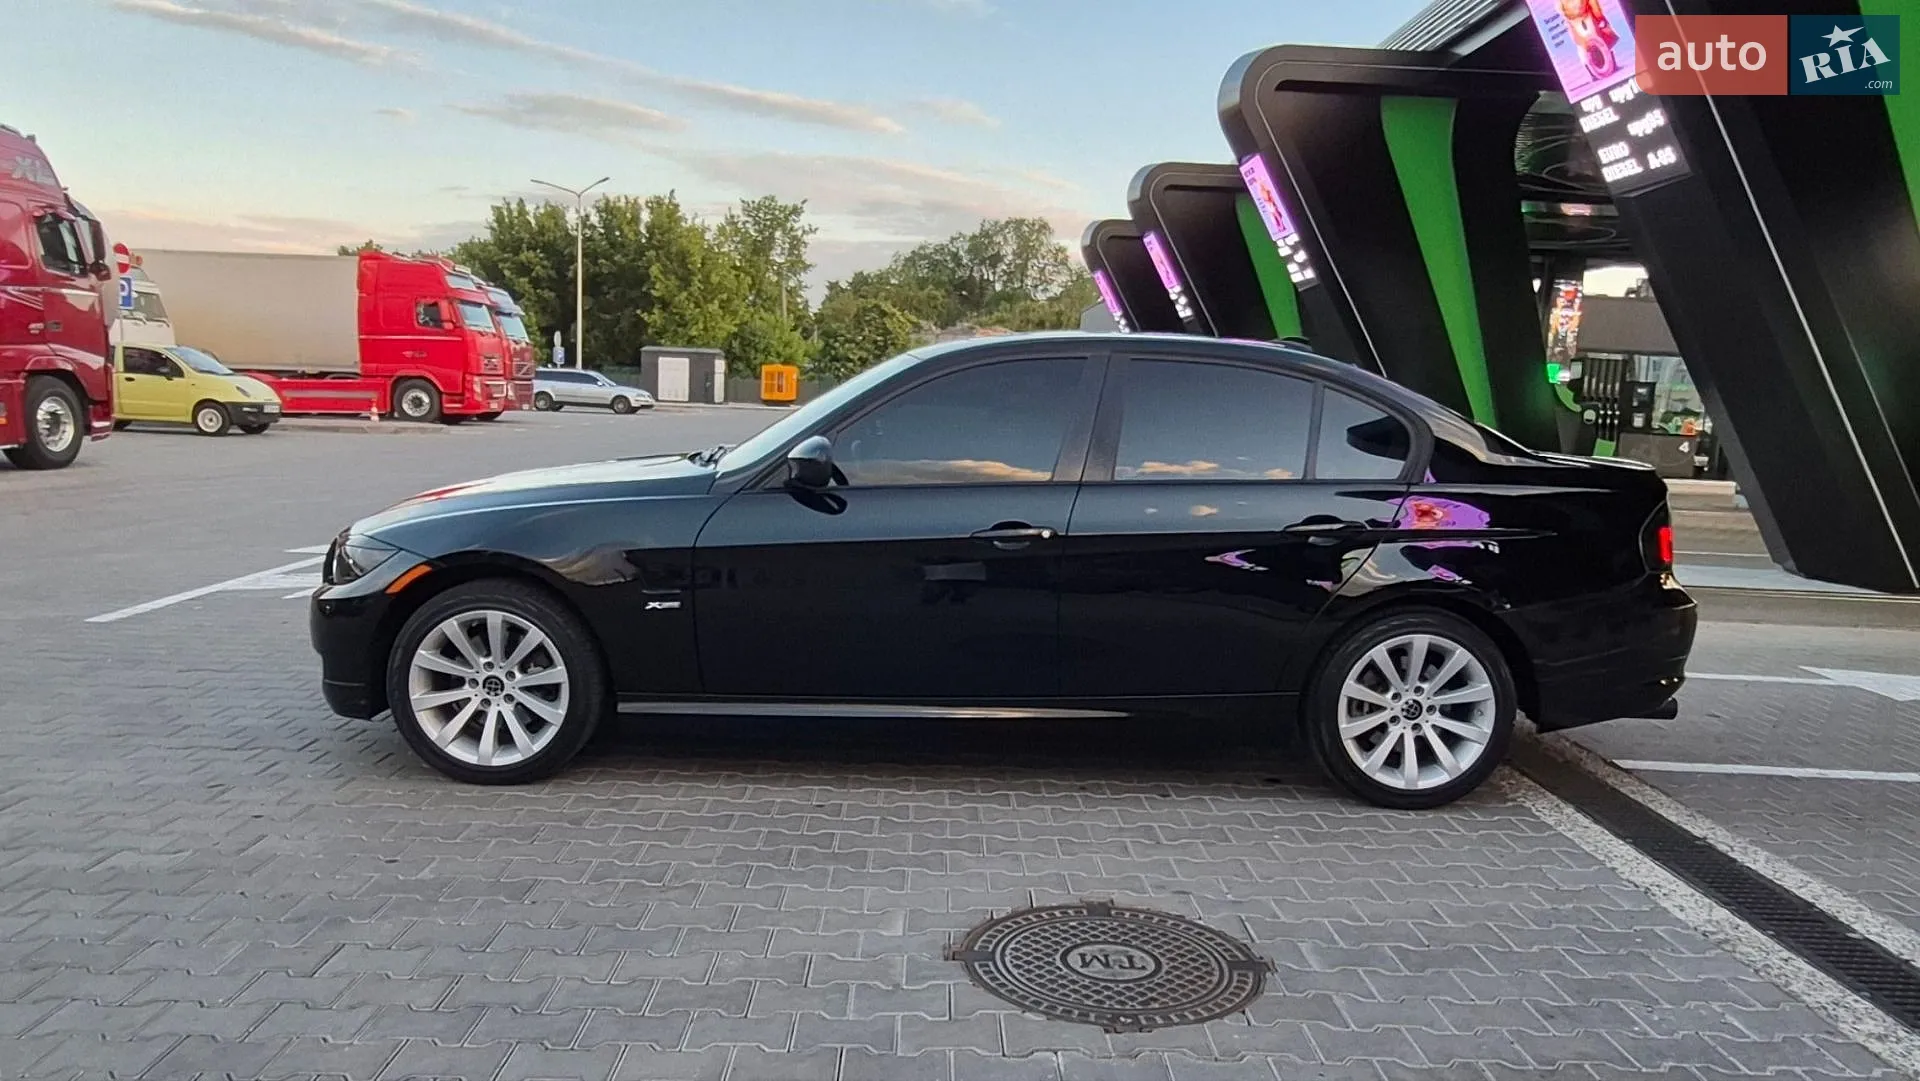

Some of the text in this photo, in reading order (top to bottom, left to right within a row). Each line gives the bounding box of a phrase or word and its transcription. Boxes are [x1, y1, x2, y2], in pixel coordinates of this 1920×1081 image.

[1579, 106, 1621, 133] DIESEL
[1597, 141, 1630, 164] EURO
[1601, 158, 1644, 183] DIESEL
[119, 280, 129, 307] P
[1678, 441, 1690, 453] 4
